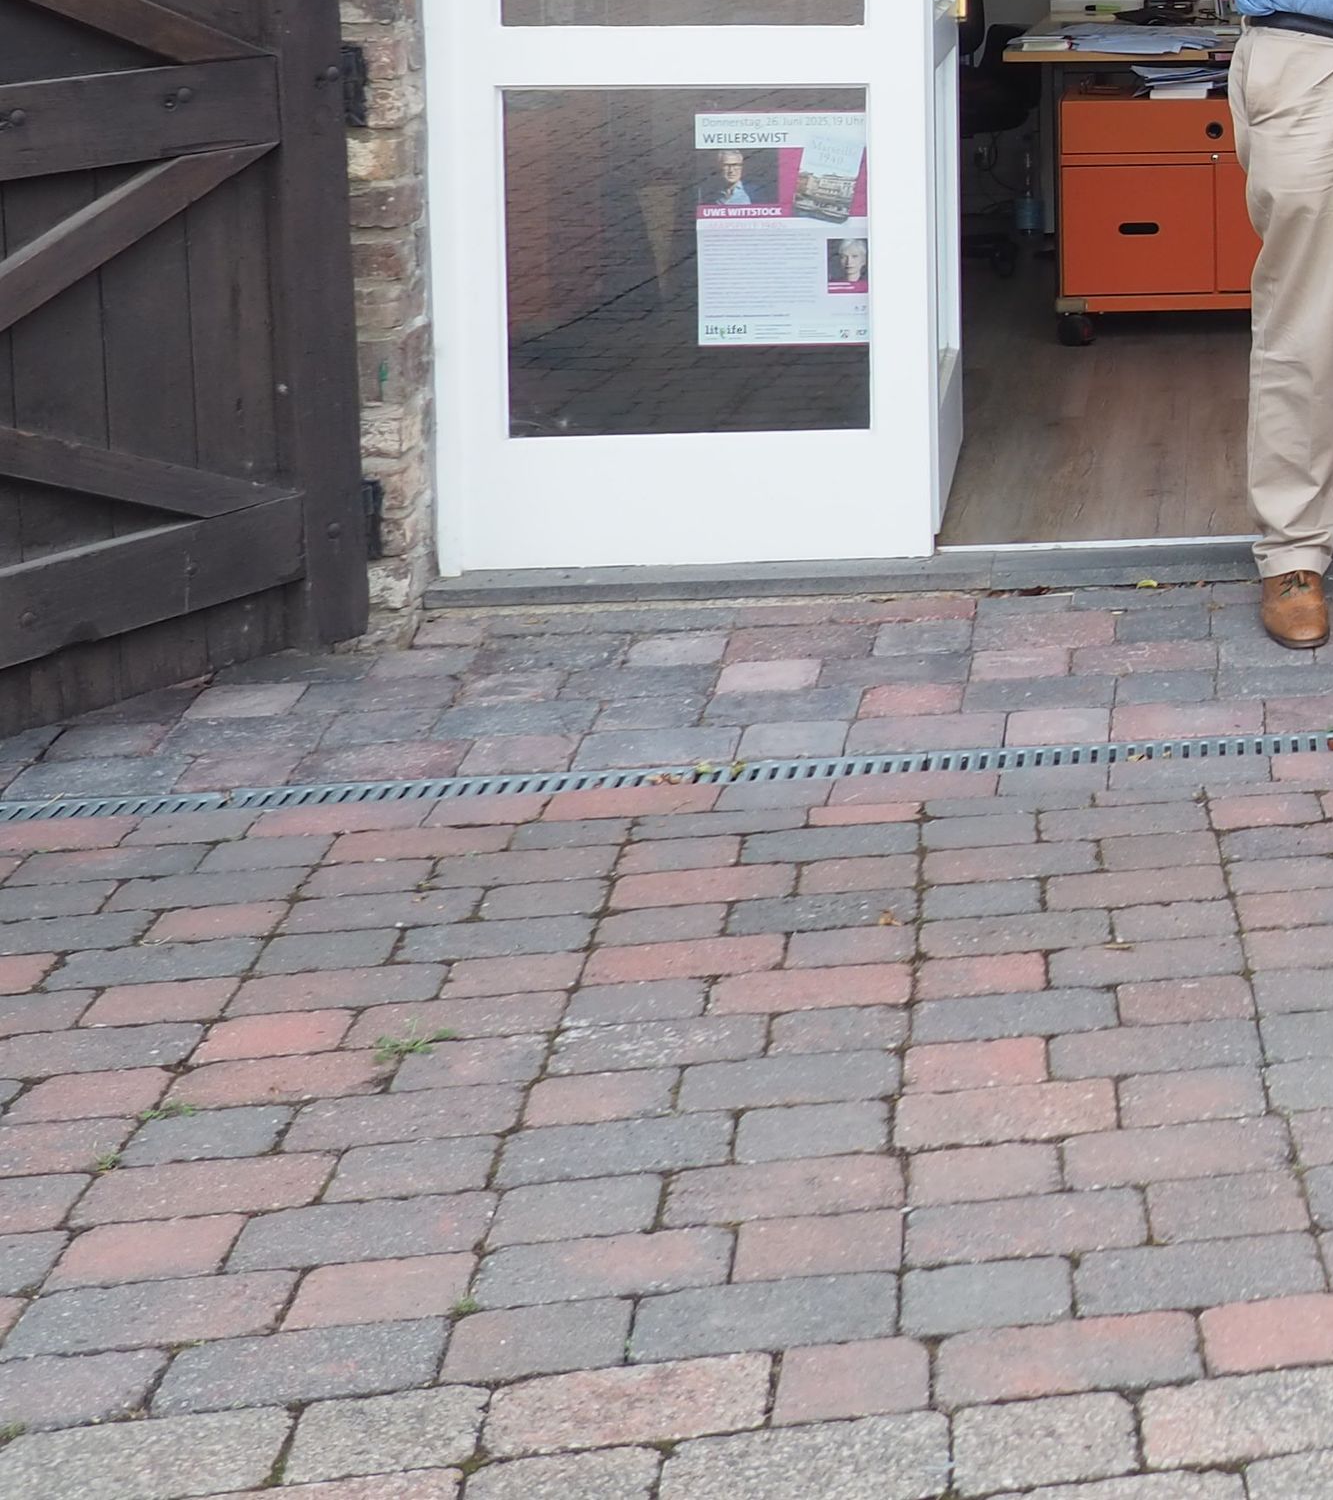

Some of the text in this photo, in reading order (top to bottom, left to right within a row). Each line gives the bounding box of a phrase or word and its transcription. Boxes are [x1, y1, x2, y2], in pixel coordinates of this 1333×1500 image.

[702, 117, 763, 130] Donnerstag,
[845, 116, 865, 126] Uhr
[703, 132, 789, 144] WEILERSWIST
[703, 207, 783, 218] UWE WITTSTOCK
